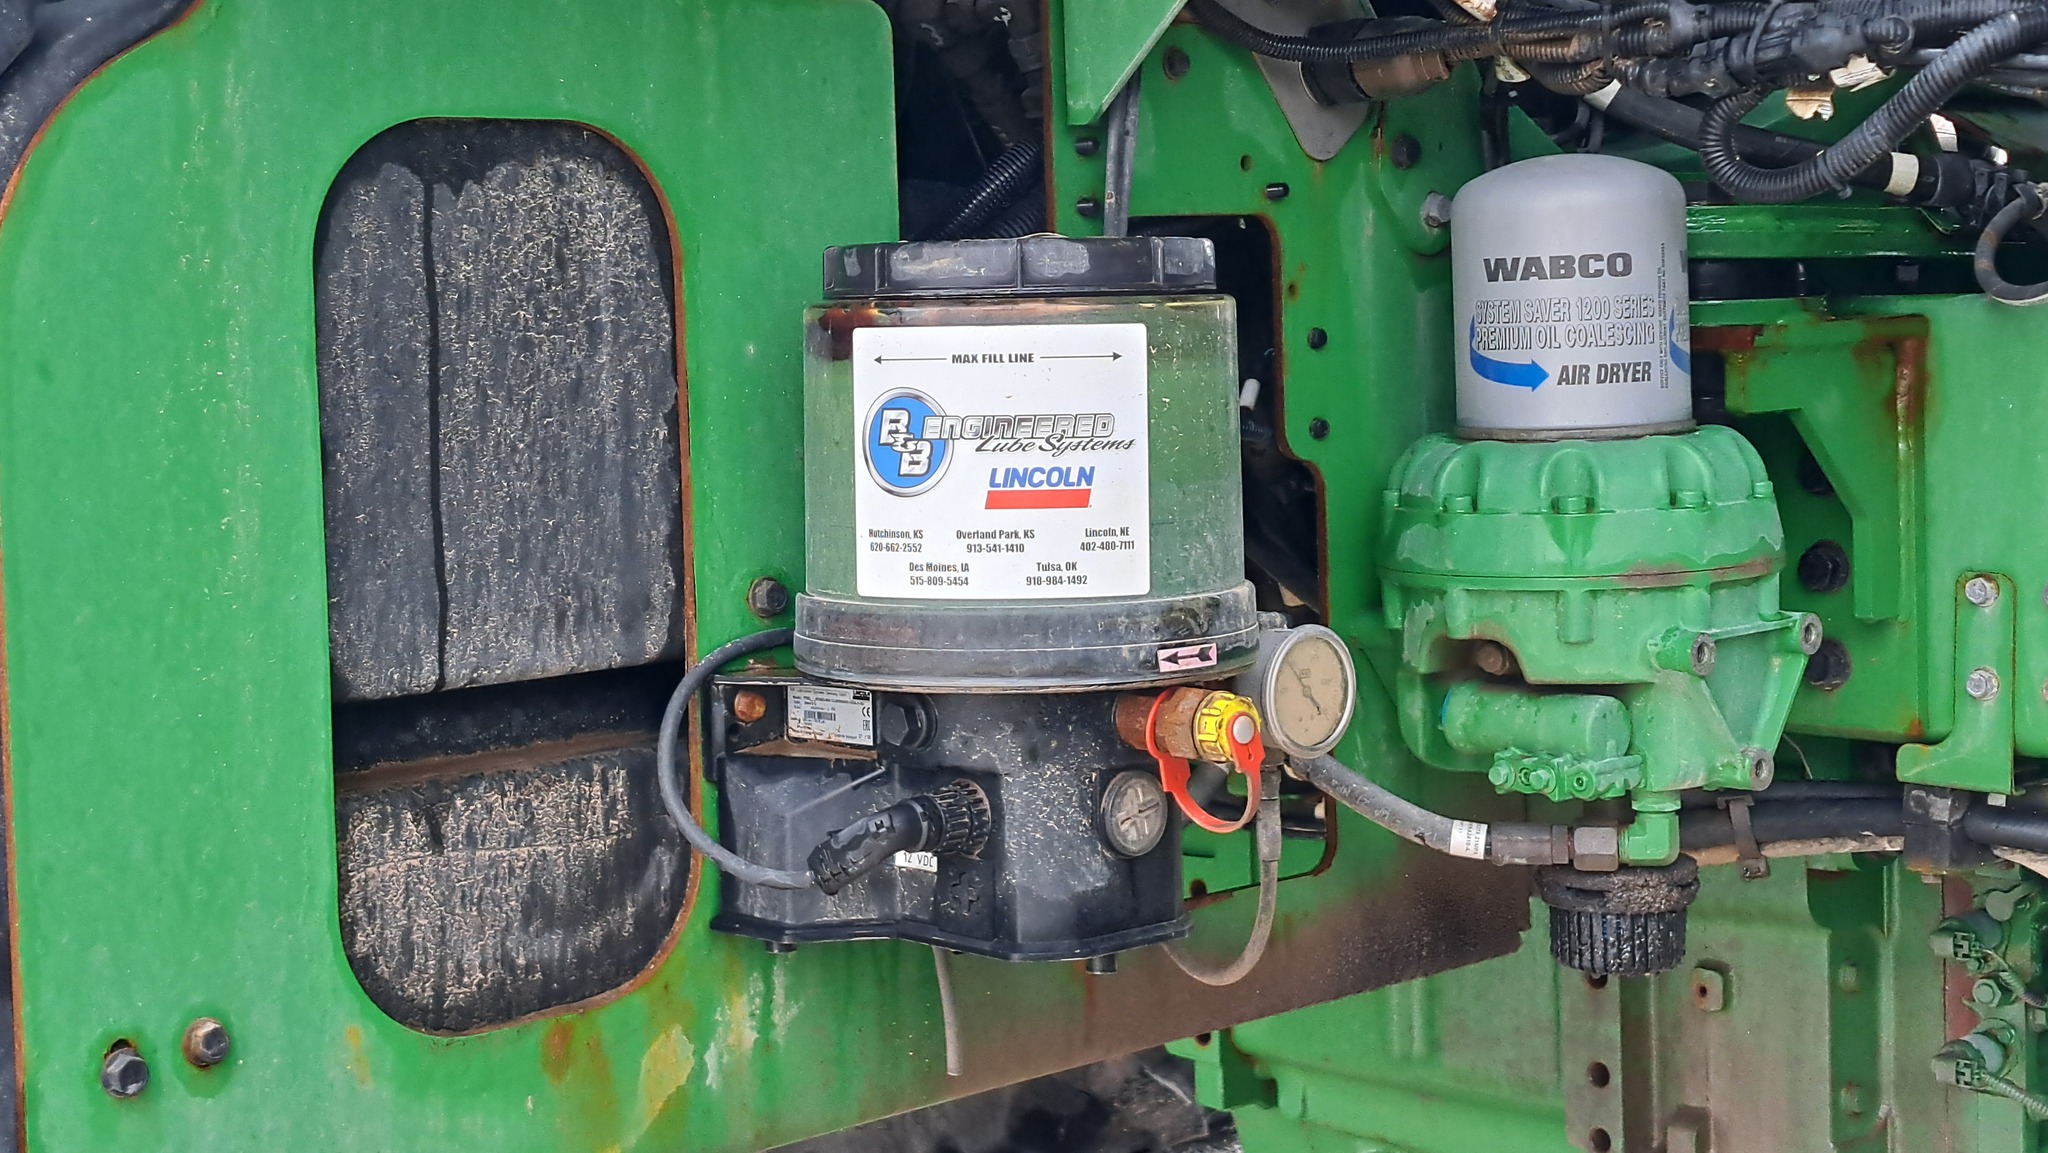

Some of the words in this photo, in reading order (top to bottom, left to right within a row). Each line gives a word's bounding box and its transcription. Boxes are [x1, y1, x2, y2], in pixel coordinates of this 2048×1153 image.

[1483, 252, 1632, 282] WABCO
[1475, 299, 1521, 324] SYSTEM
[1523, 297, 1571, 323] SAVER
[1576, 295, 1611, 321] 1200
[1613, 294, 1655, 320] SERIES
[1475, 325, 1532, 350] PREMIUM
[1536, 324, 1561, 349] OIL
[1564, 321, 1655, 348] COALESCING
[952, 353, 979, 364] MAX
[981, 353, 1005, 364] FILL
[1008, 353, 1035, 363] LINE
[1556, 363, 1591, 386] AIR
[1596, 361, 1651, 384] DRYER
[922, 412, 1115, 440] ENGINEERED
[975, 436, 1036, 453] Lube
[1038, 433, 1137, 457] Systems
[989, 466, 1096, 488] LINCOLN
[868, 528, 911, 541] Hutchinson,
[913, 529, 924, 539] KS
[956, 529, 997, 540] Overland
[999, 529, 1021, 541] Park,
[1023, 529, 1035, 540] KS
[1084, 527, 1118, 539] Lincoln,
[1119, 527, 1130, 537] NE
[869, 542, 922, 553] 620-662-2552
[966, 543, 1025, 554] 913-541-1410
[1079, 540, 1135, 552] 402-480-7111
[908, 562, 924, 573] Des
[926, 562, 959, 574] Moines,
[1036, 561, 1063, 573] Tulsa,
[1064, 561, 1077, 571] OK
[909, 575, 969, 587] 515-809-5454
[1026, 575, 1088, 587] 918-984-1492
[904, 852, 913, 864] 12
[916, 853, 934, 868] VDC
